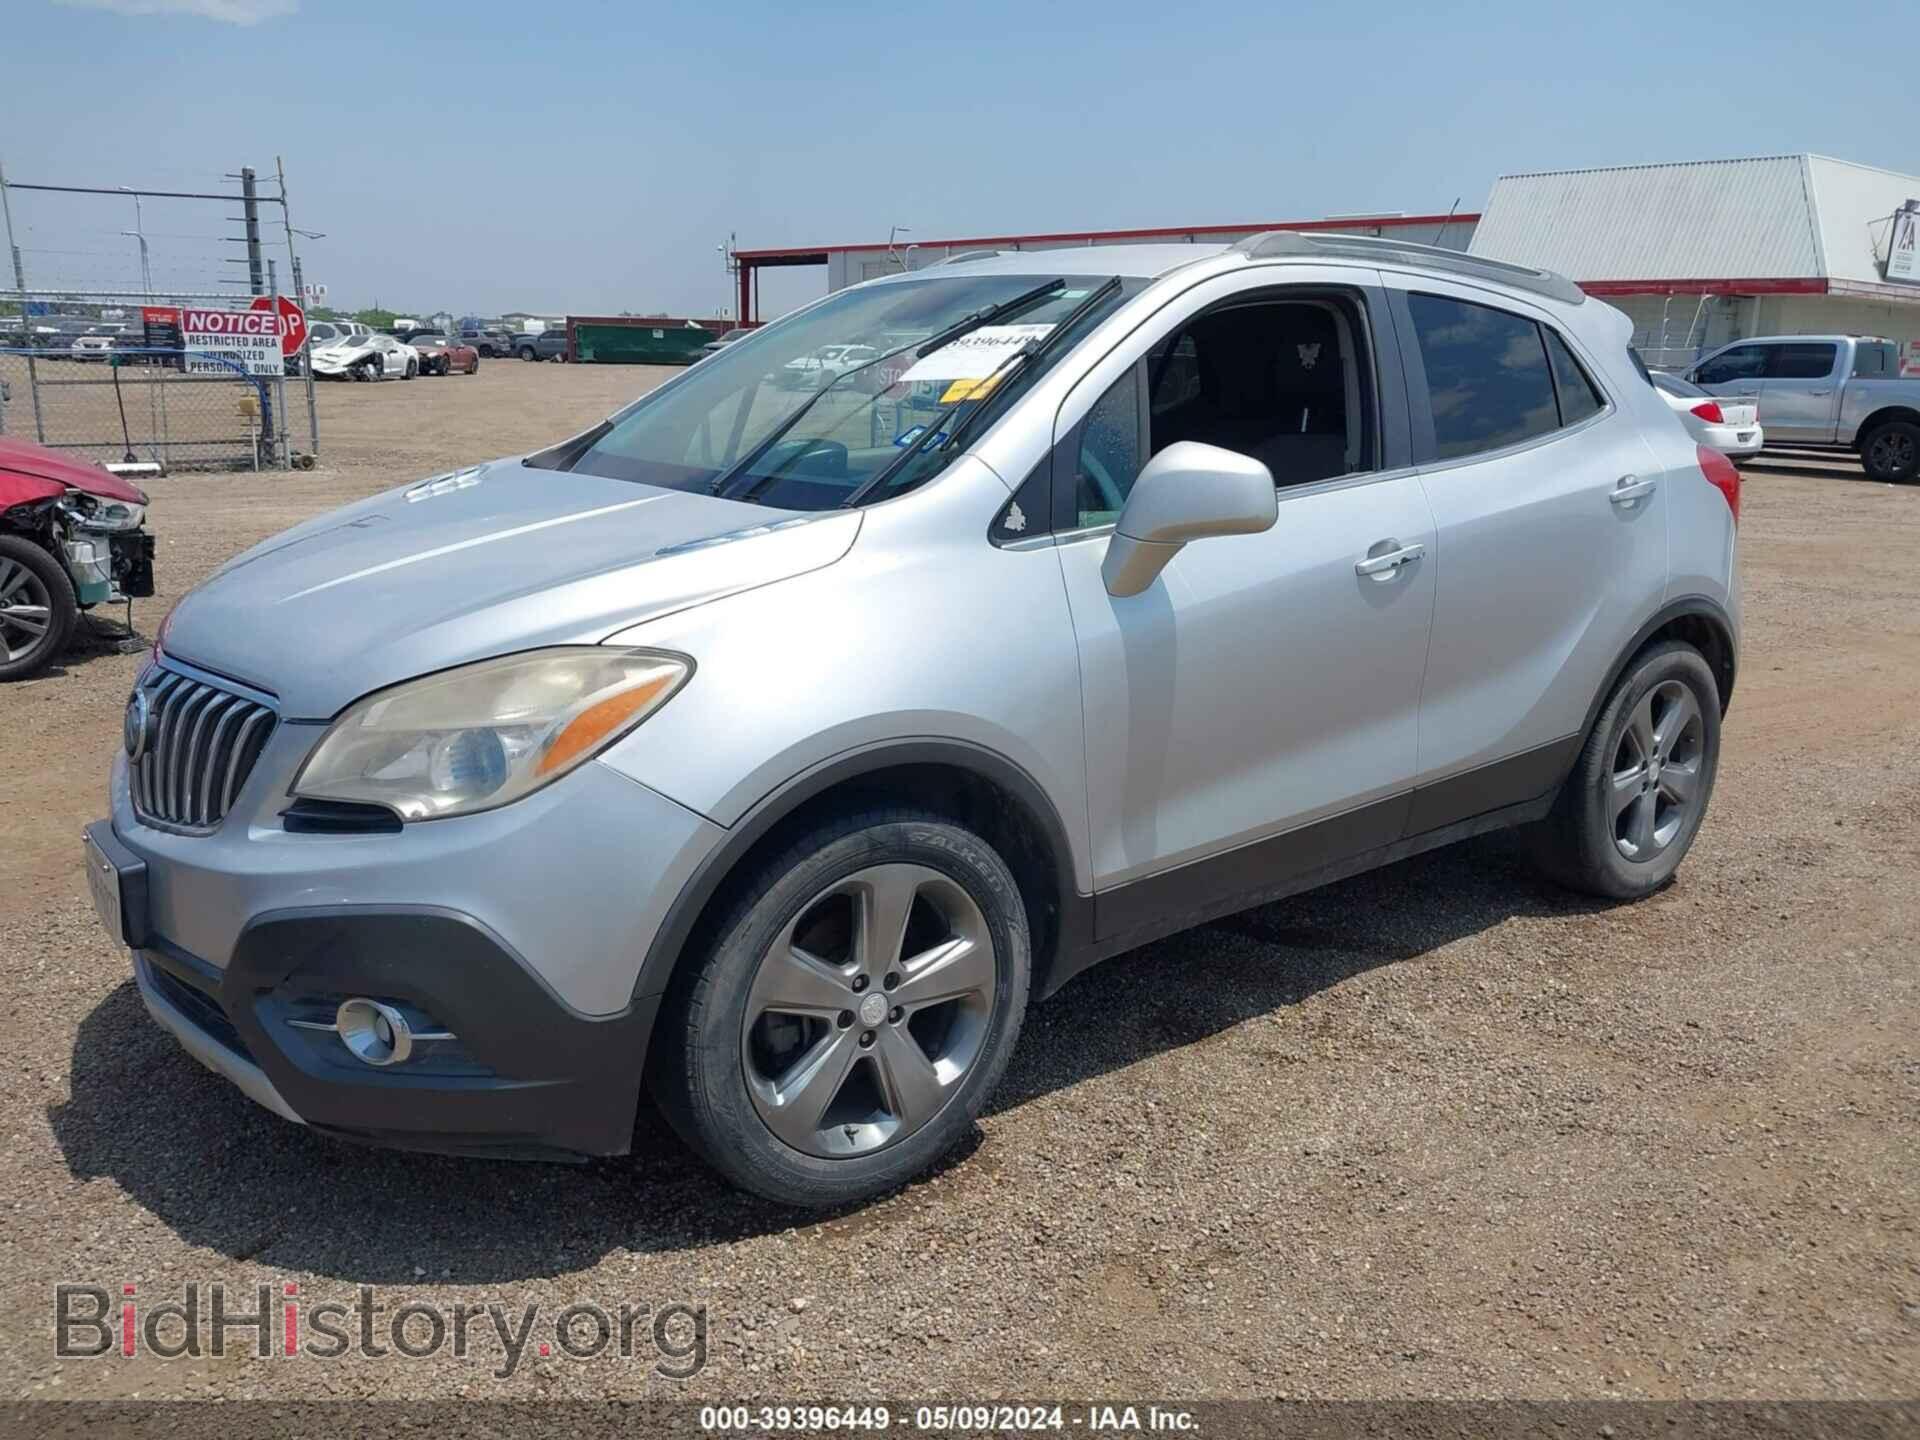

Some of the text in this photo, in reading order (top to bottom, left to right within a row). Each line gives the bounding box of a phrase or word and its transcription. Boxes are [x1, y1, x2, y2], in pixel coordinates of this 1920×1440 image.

[188, 313, 275, 334] NOTICE
[188, 335, 277, 348] RESTRICTED AREA
[254, 364, 279, 374] ONLY
